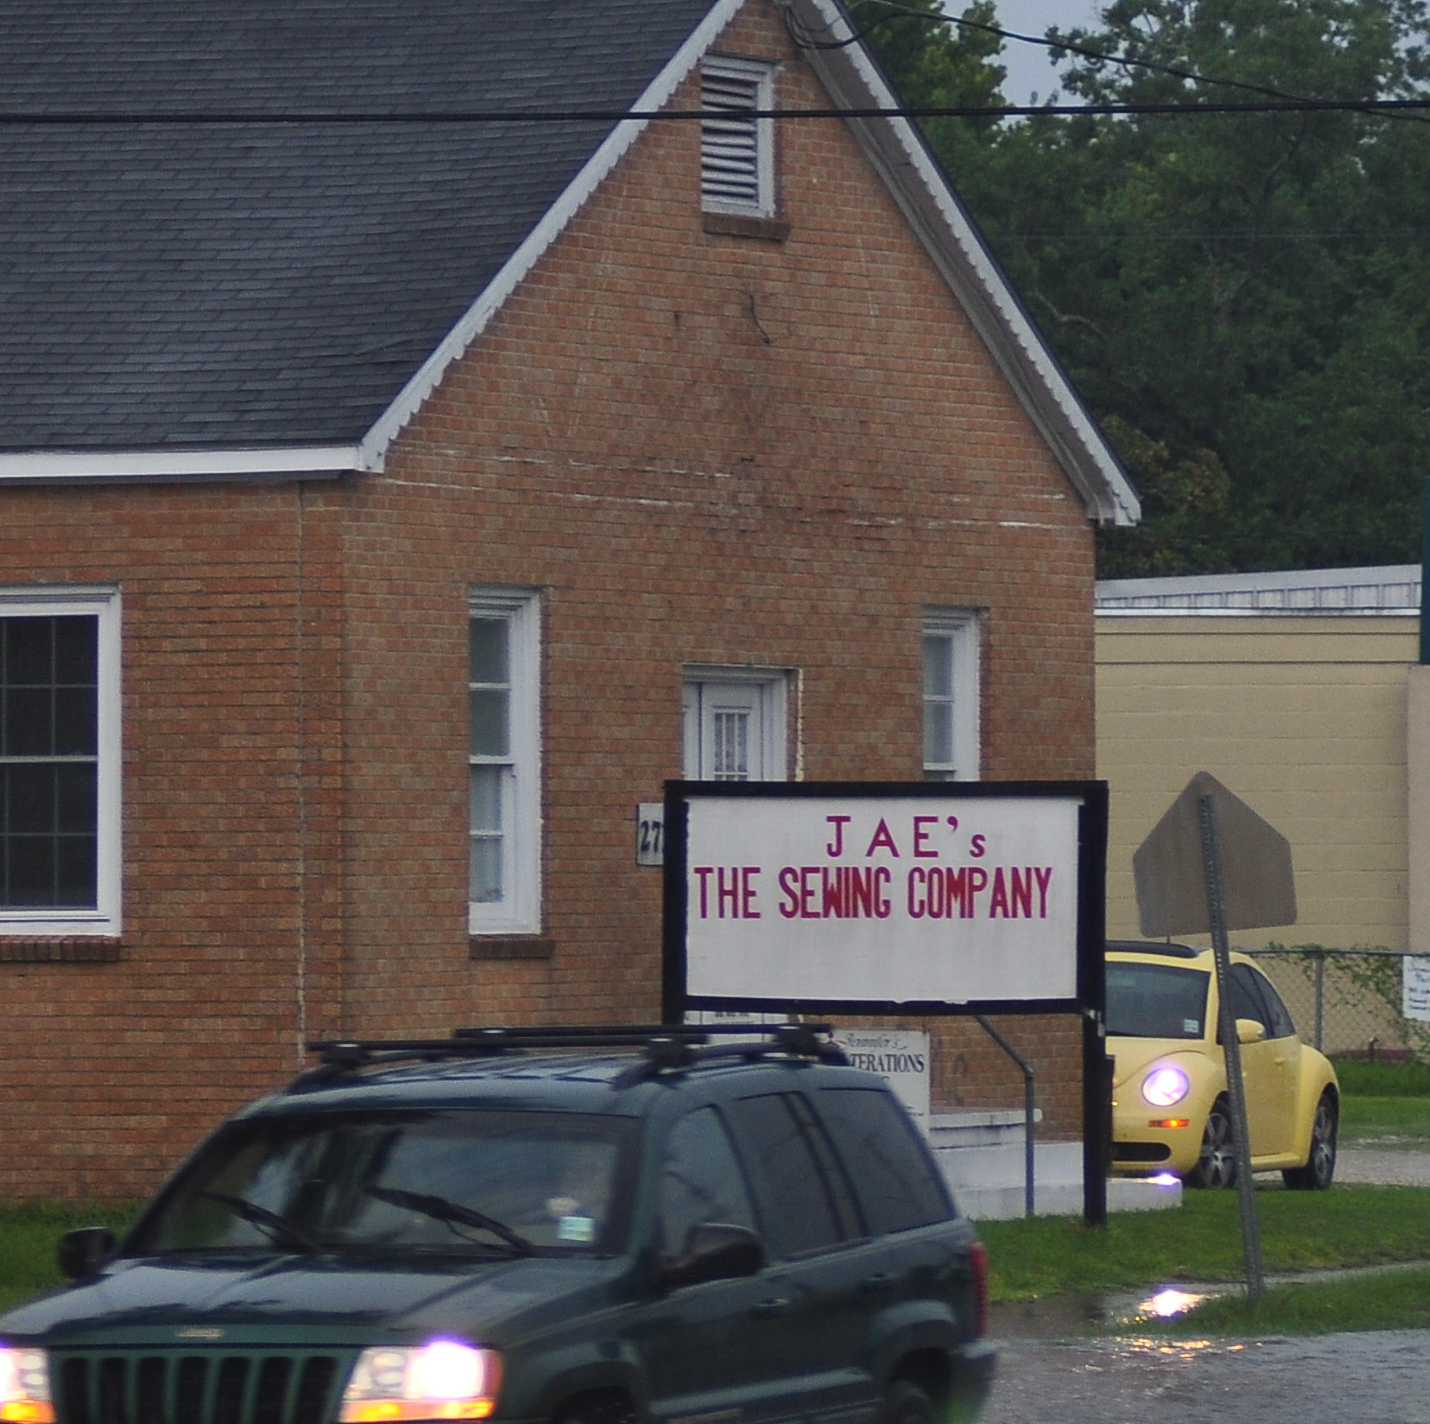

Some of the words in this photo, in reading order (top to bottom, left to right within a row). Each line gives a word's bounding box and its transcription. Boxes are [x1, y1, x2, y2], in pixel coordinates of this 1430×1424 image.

[826, 815, 986, 859] JAE's
[693, 866, 762, 919] THE
[778, 866, 892, 919] SEWING
[907, 866, 1053, 919] COMPANY
